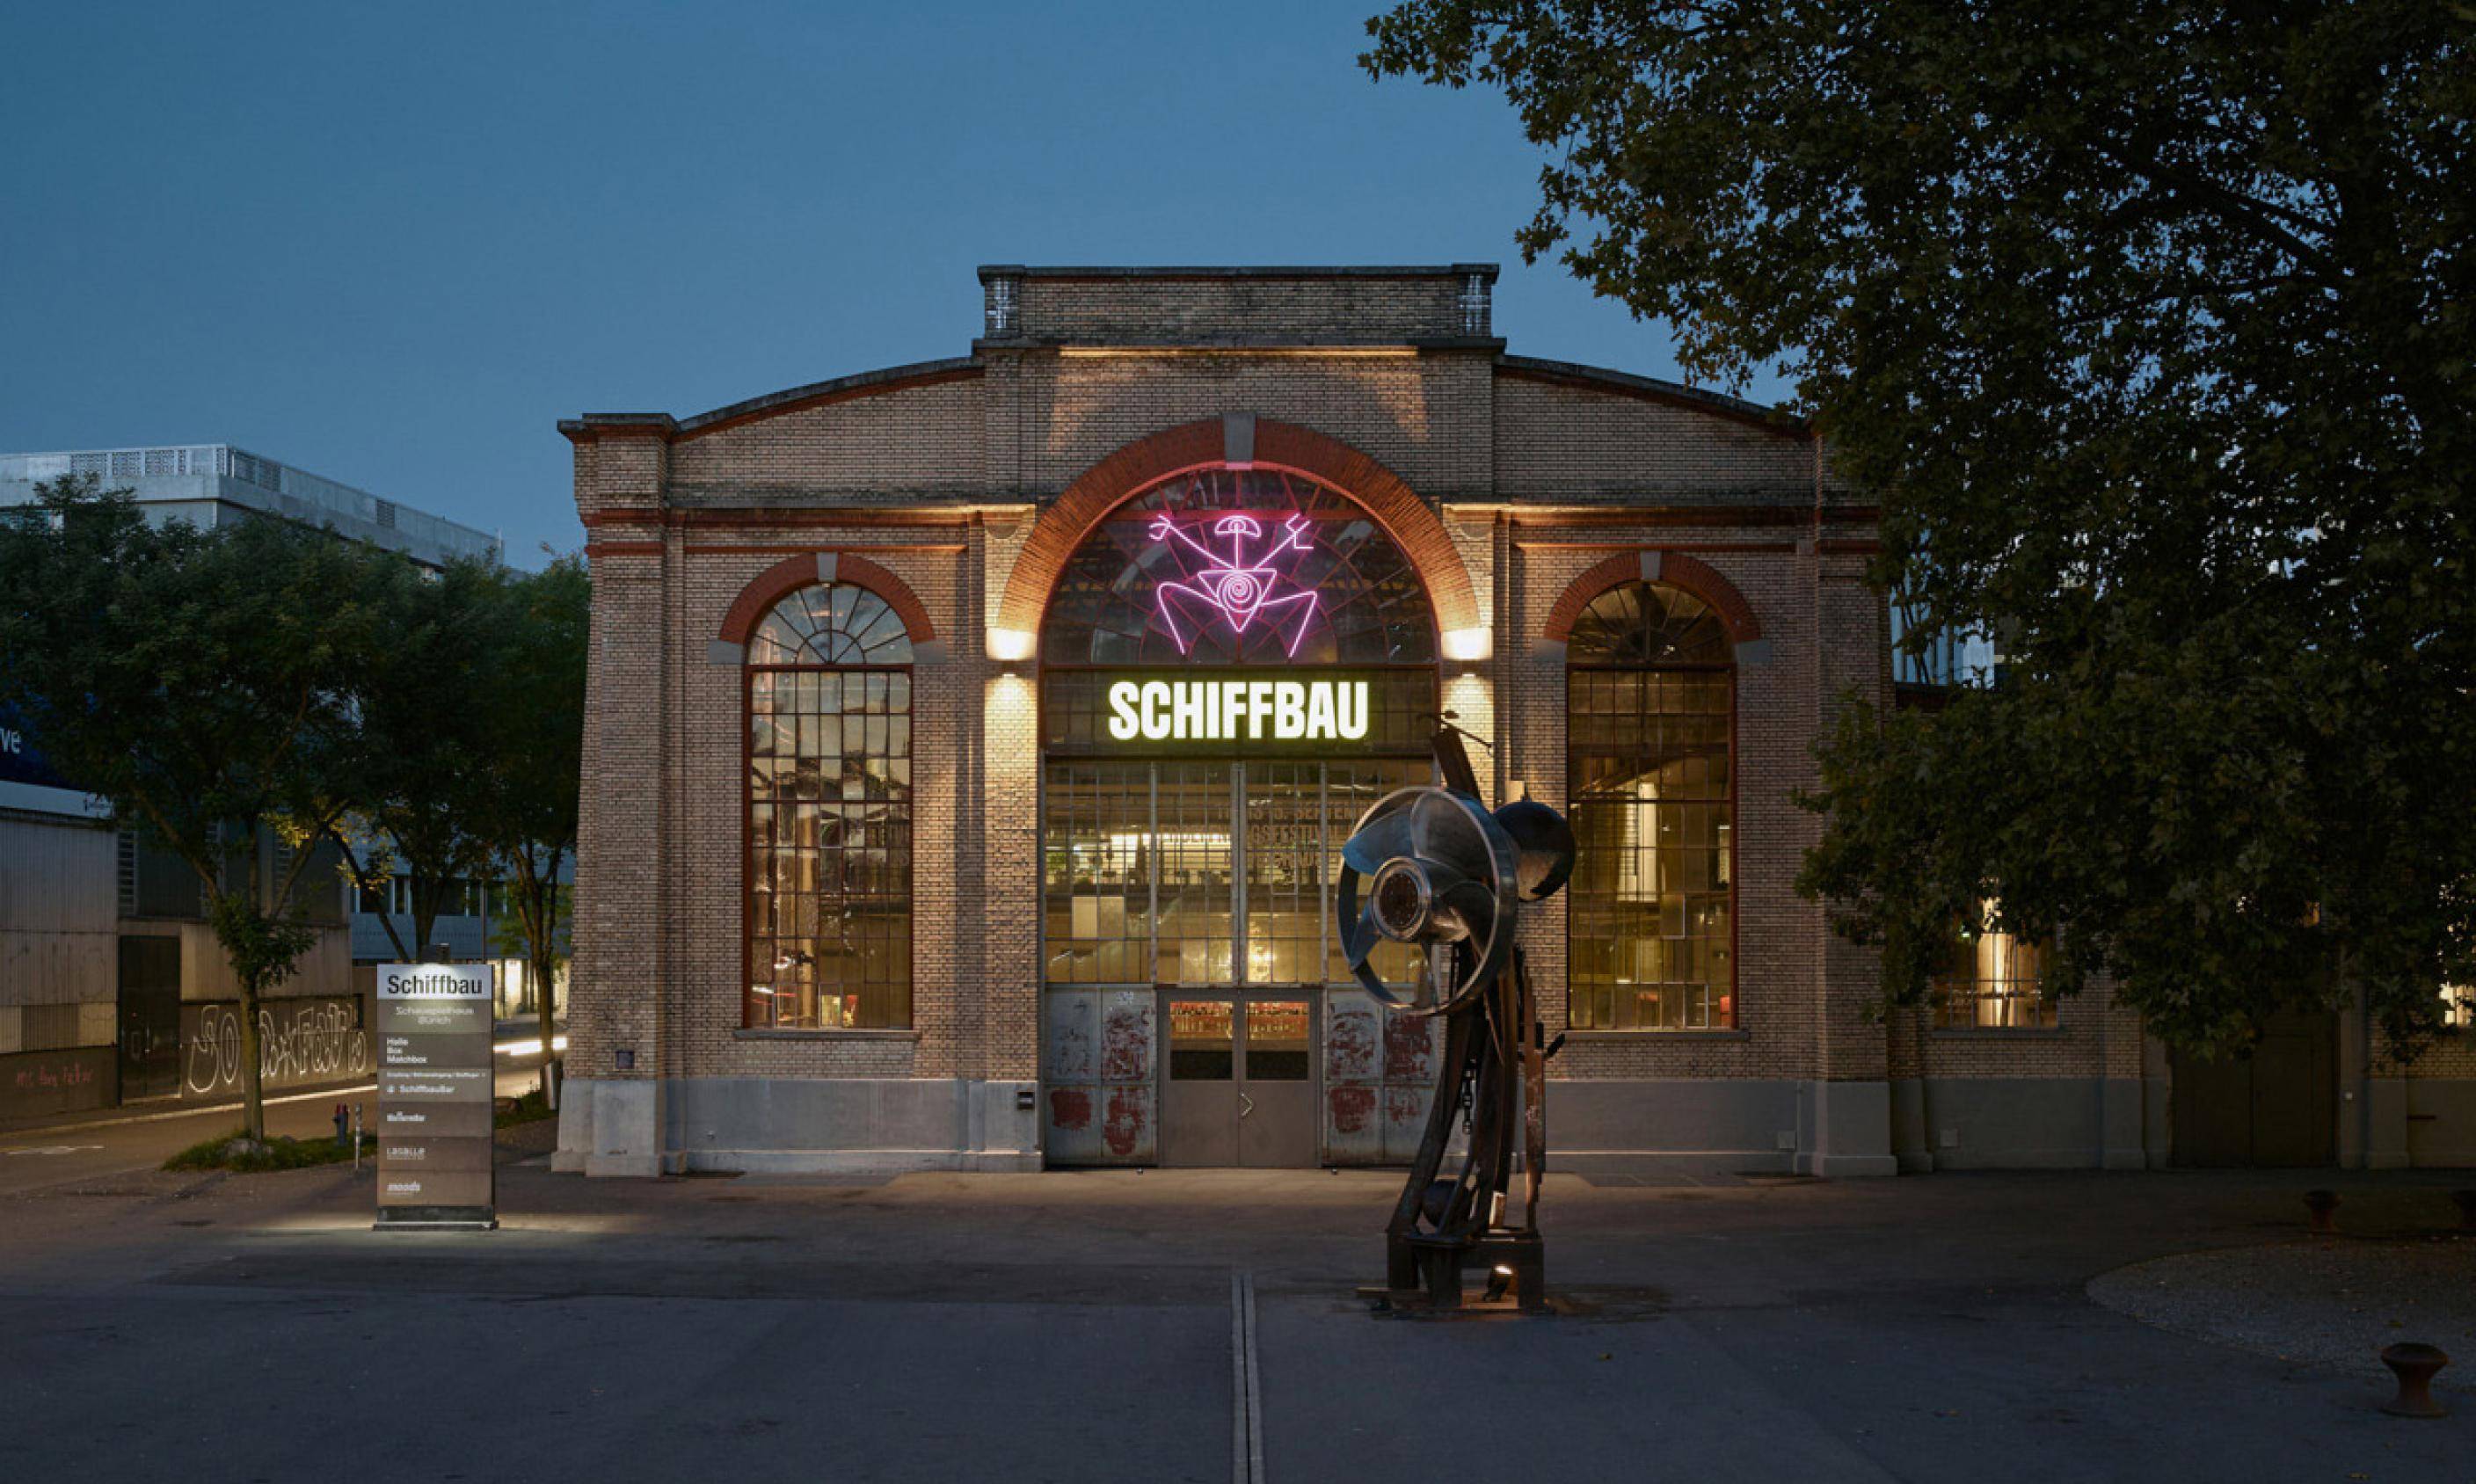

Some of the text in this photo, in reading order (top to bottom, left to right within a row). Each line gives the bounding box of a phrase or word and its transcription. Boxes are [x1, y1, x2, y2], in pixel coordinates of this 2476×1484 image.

[1109, 680, 1368, 739] SCHIFFBAU
[388, 974, 483, 994] Schiffbau
[387, 1055, 427, 1064] Matchbox
